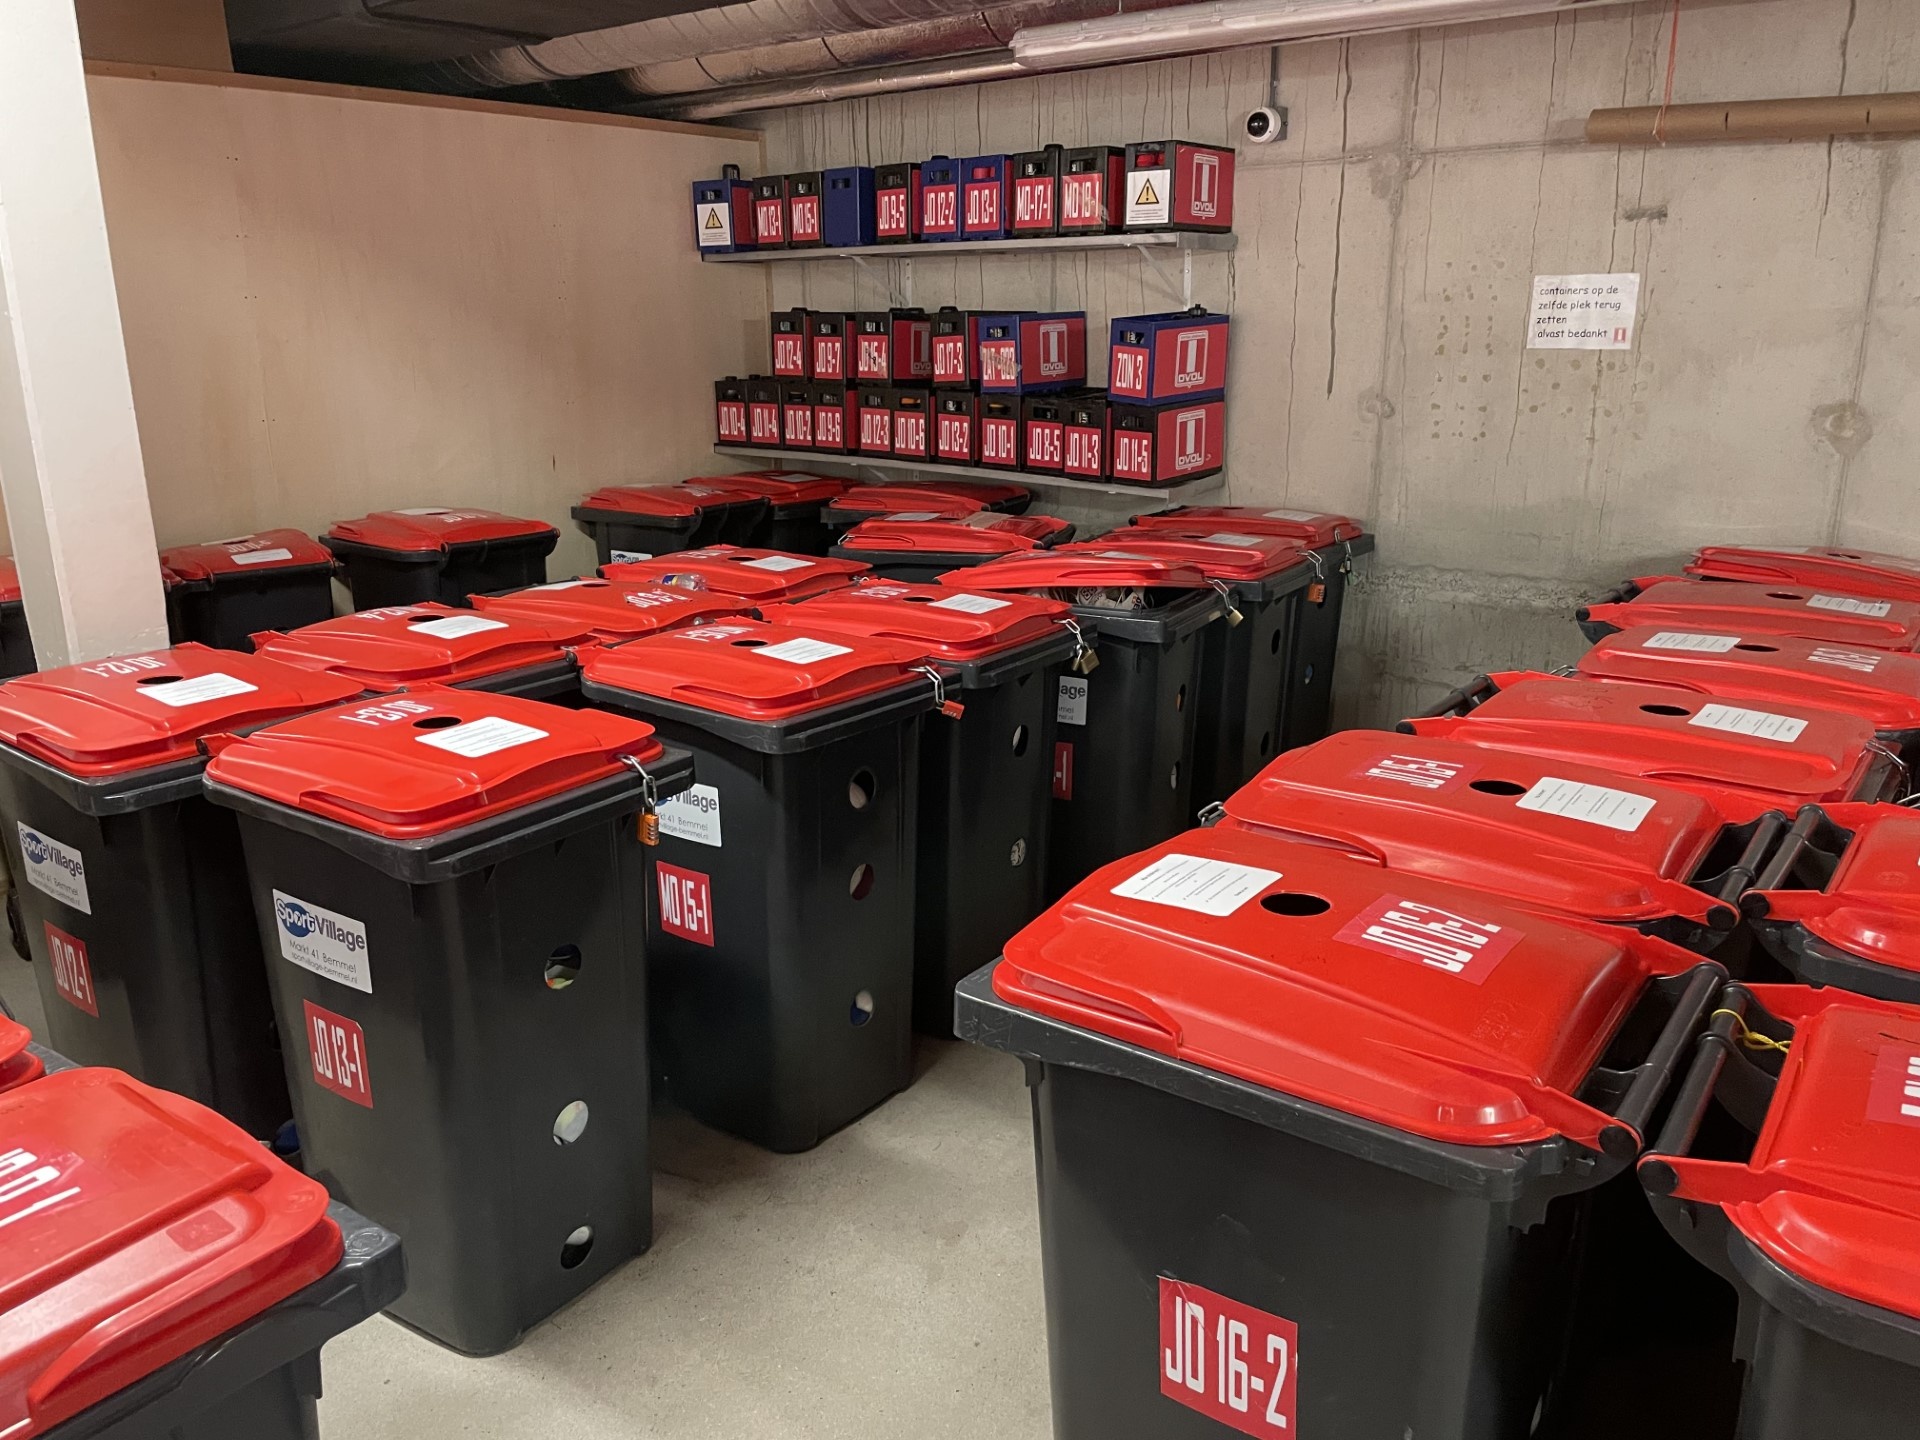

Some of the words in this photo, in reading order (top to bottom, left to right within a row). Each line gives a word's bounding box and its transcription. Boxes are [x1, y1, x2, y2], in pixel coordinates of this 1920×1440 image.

[880, 195, 889, 230] JO
[890, 194, 905, 229] 9-5
[925, 192, 936, 226] JO
[938, 191, 955, 226] 12-2
[968, 189, 979, 224] JO
[981, 188, 997, 224] 13-1
[1016, 184, 1051, 221] MO-17-1
[1064, 182, 1079, 219] MO
[768, 204, 782, 237] 13-1
[1538, 300, 1568, 310] zelfde
[1570, 300, 1591, 312] plek
[1594, 301, 1621, 311] terug
[1540, 287, 1589, 296] containers
[1592, 287, 1604, 298] op
[1606, 285, 1619, 294] de
[1536, 316, 1567, 324] zetten
[1537, 328, 1565, 338] alvast
[1568, 328, 1608, 338] bedankt
[776, 340, 785, 369] JO
[786, 340, 802, 370] 12-4
[816, 342, 826, 373] JO
[827, 342, 841, 373] 9-7
[859, 341, 868, 372] JO
[935, 343, 945, 375] JO
[946, 342, 963, 374] 17-3
[1116, 352, 1135, 389] ZON
[1136, 355, 1144, 390] 3
[1178, 372, 1203, 383] DVOL
[720, 406, 729, 435] JO
[753, 408, 762, 437] JO
[763, 408, 778, 438] 11-4
[786, 410, 795, 440] JO
[796, 410, 812, 441] 10-2
[818, 411, 826, 441] JO
[827, 412, 841, 442] 9-6
[862, 414, 871, 444] JO
[873, 414, 889, 445] 12-3
[895, 417, 906, 449] JO
[908, 418, 925, 450] 10-6
[939, 420, 950, 451] JO
[951, 421, 968, 453] 13-2
[985, 424, 996, 457] JO
[998, 425, 1014, 459] 10-1
[1030, 427, 1041, 460] JO
[1044, 428, 1060, 462] 8-5
[1067, 427, 1079, 467] JO
[1082, 428, 1099, 469] 11-3
[1117, 437, 1129, 471] JO
[1131, 438, 1148, 473] 11-5
[1179, 453, 1202, 465] DVOL
[81, 661, 140, 678] 12-1
[124, 656, 167, 669] JO
[339, 706, 408, 726] 13-1
[381, 700, 434, 714] JO
[1365, 768, 1446, 789] JO
[1378, 754, 1464, 779] 15-1
[660, 871, 681, 926] MO
[682, 878, 709, 935] 15-1
[276, 898, 366, 952] SportVillage
[1380, 900, 1503, 949] 16-2
[51, 935, 70, 992] JO
[311, 948, 320, 960] 41
[323, 952, 357, 975] Bemmel
[1361, 925, 1474, 973] JO
[313, 1016, 333, 1080] JO
[331, 1024, 366, 1094] 13-1
[1165, 1295, 1205, 1394] JO
[1216, 1313, 1288, 1429] 16-2
